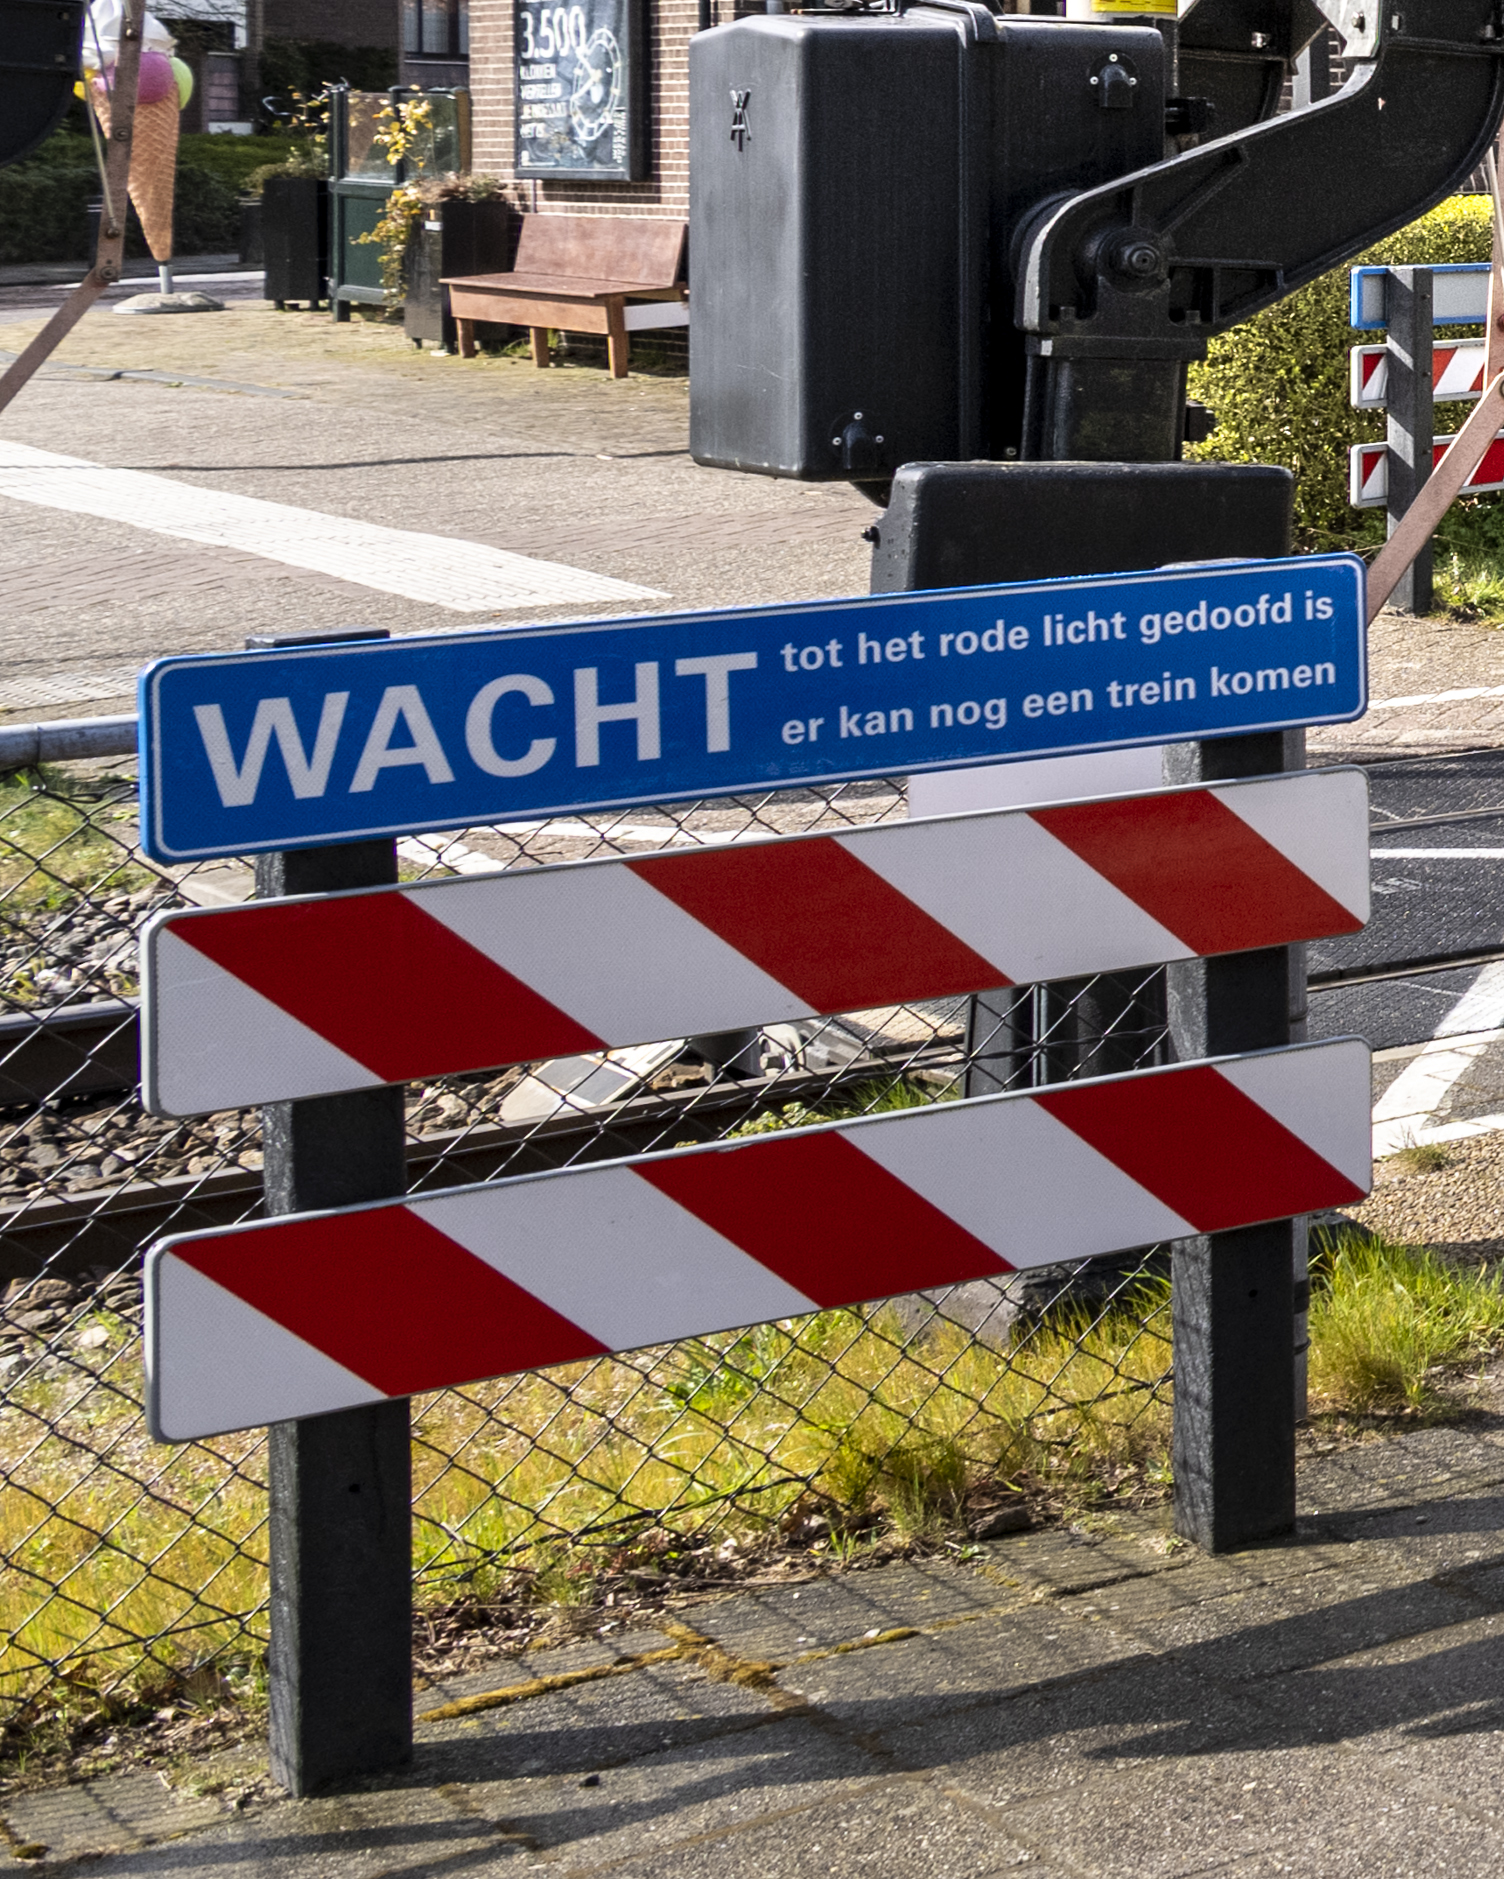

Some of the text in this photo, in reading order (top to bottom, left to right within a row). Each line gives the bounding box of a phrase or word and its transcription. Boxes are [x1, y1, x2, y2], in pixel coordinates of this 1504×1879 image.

[520, 5, 586, 59] 3.500
[193, 591, 1334, 808] WACHT tot het rode licht gedoofd is
[781, 661, 1336, 745] er kan nog een trein komen
